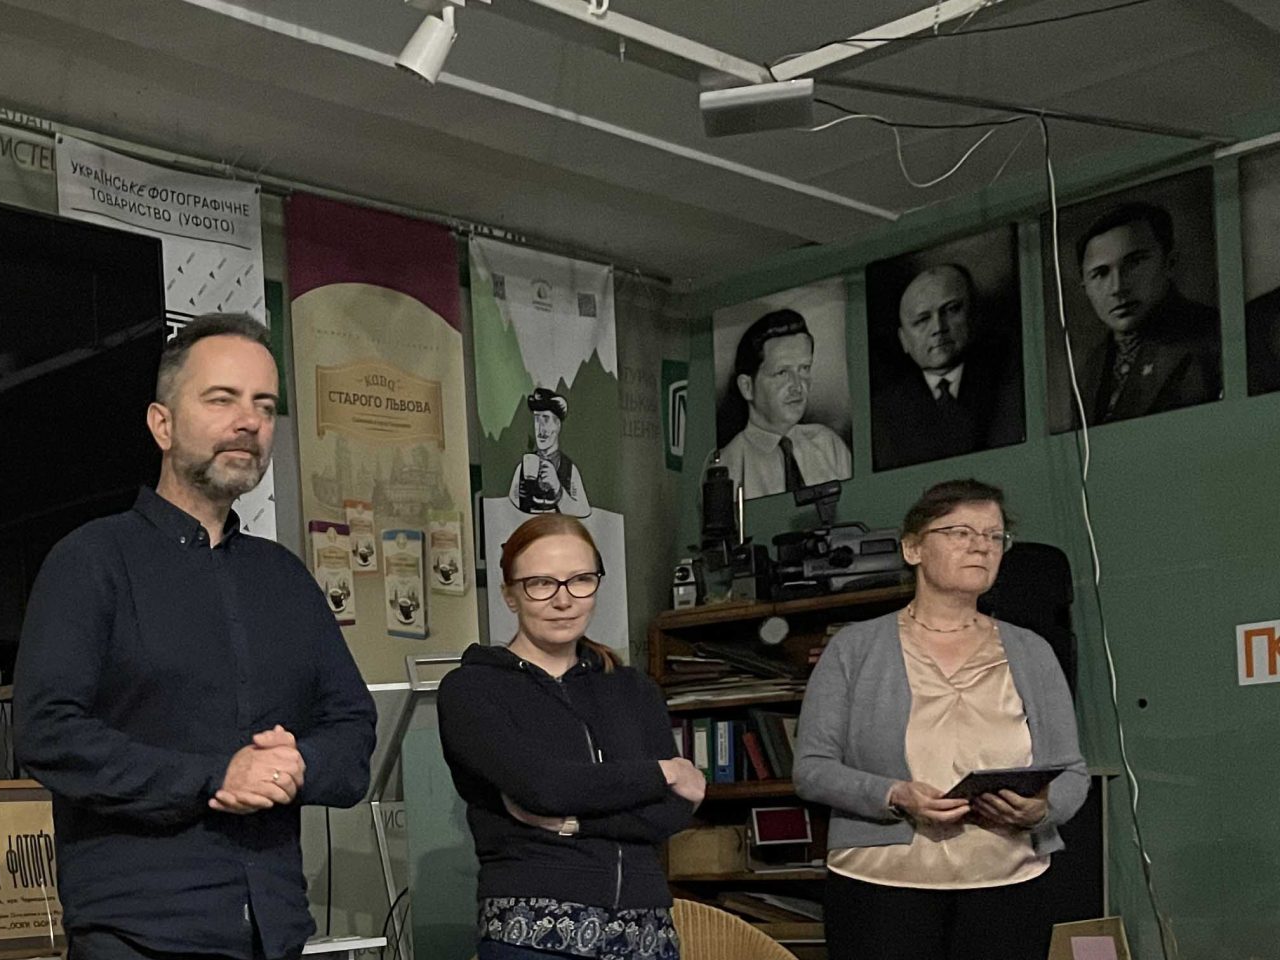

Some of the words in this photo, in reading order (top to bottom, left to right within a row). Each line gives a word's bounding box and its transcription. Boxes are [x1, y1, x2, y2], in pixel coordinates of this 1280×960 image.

[70, 160, 147, 197] УКРАЇНСЬКЕ
[89, 187, 172, 222] ТОВАРИСТВО
[178, 213, 236, 234] (УФОТО)
[328, 391, 382, 408] СТАРОГО
[385, 397, 432, 414] ЛЬВОВА
